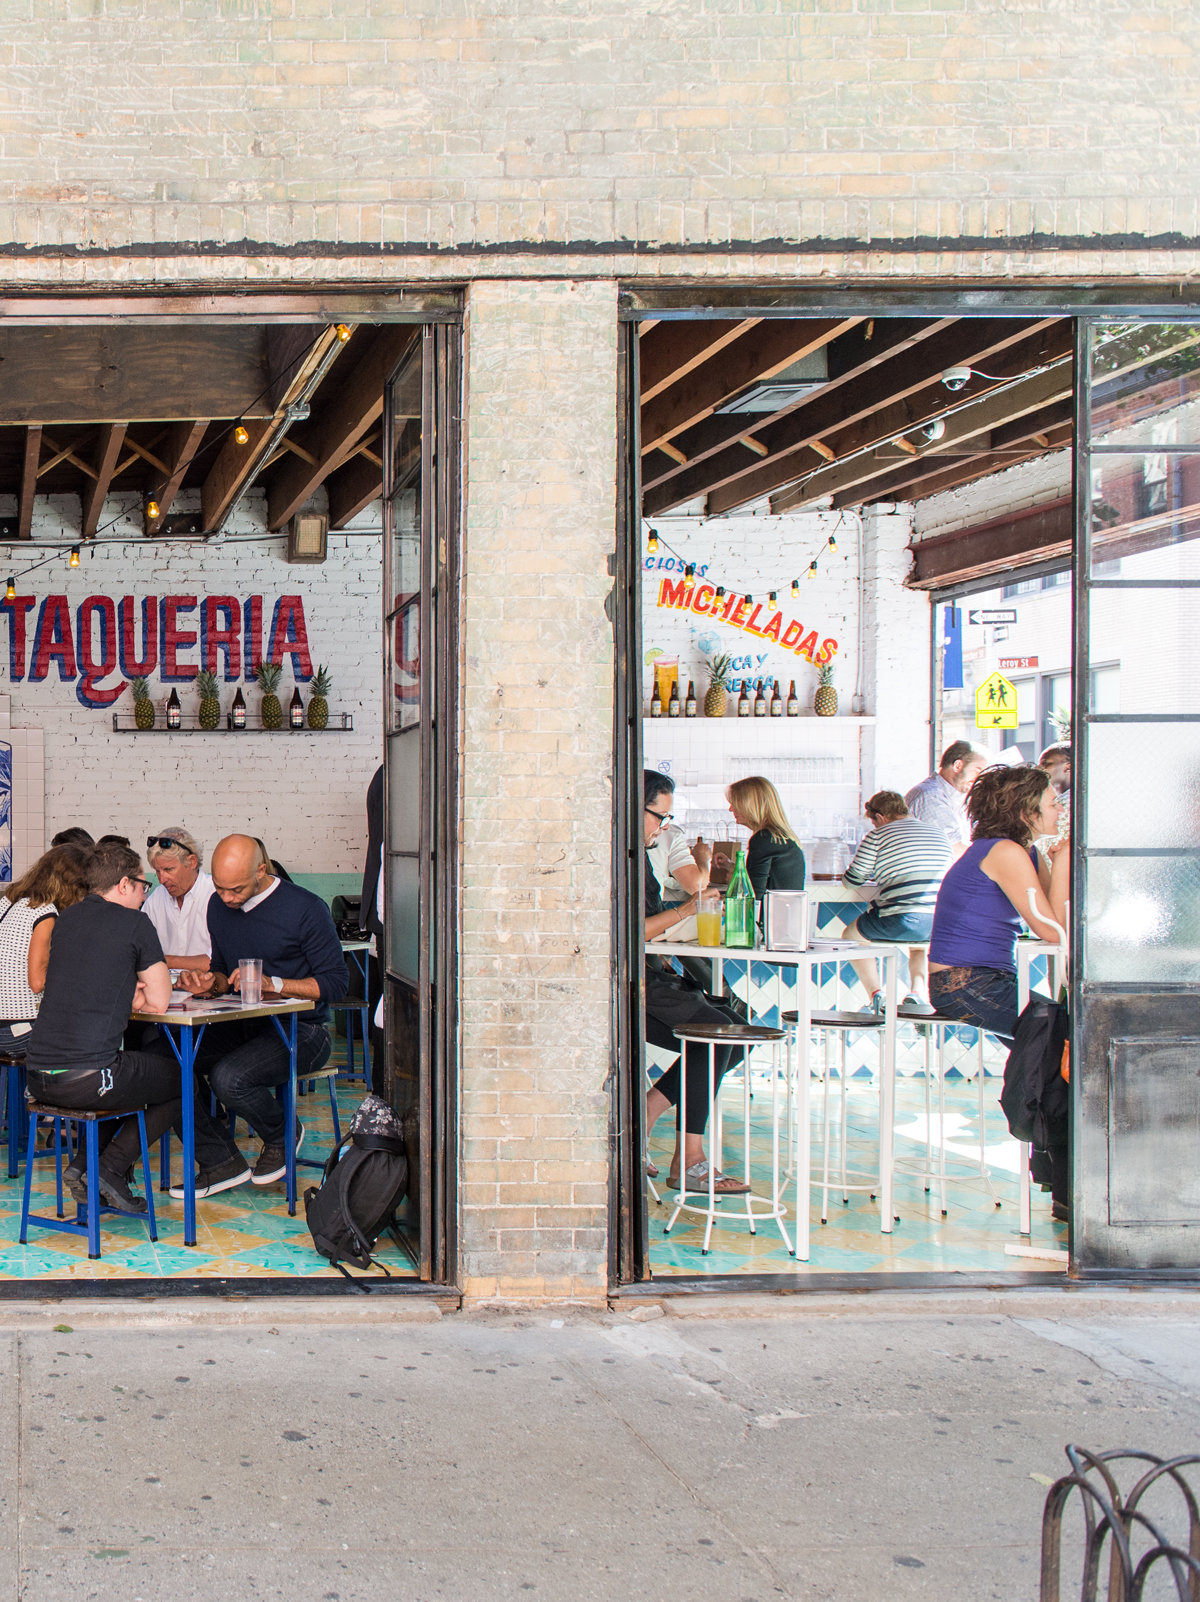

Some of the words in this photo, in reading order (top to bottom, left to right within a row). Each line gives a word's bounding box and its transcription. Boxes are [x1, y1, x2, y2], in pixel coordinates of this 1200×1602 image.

[657, 578, 839, 669] MICHELADAS
[756, 653, 769, 669] Y
[998, 658, 1019, 669] Leroy
[1020, 658, 1030, 667] St
